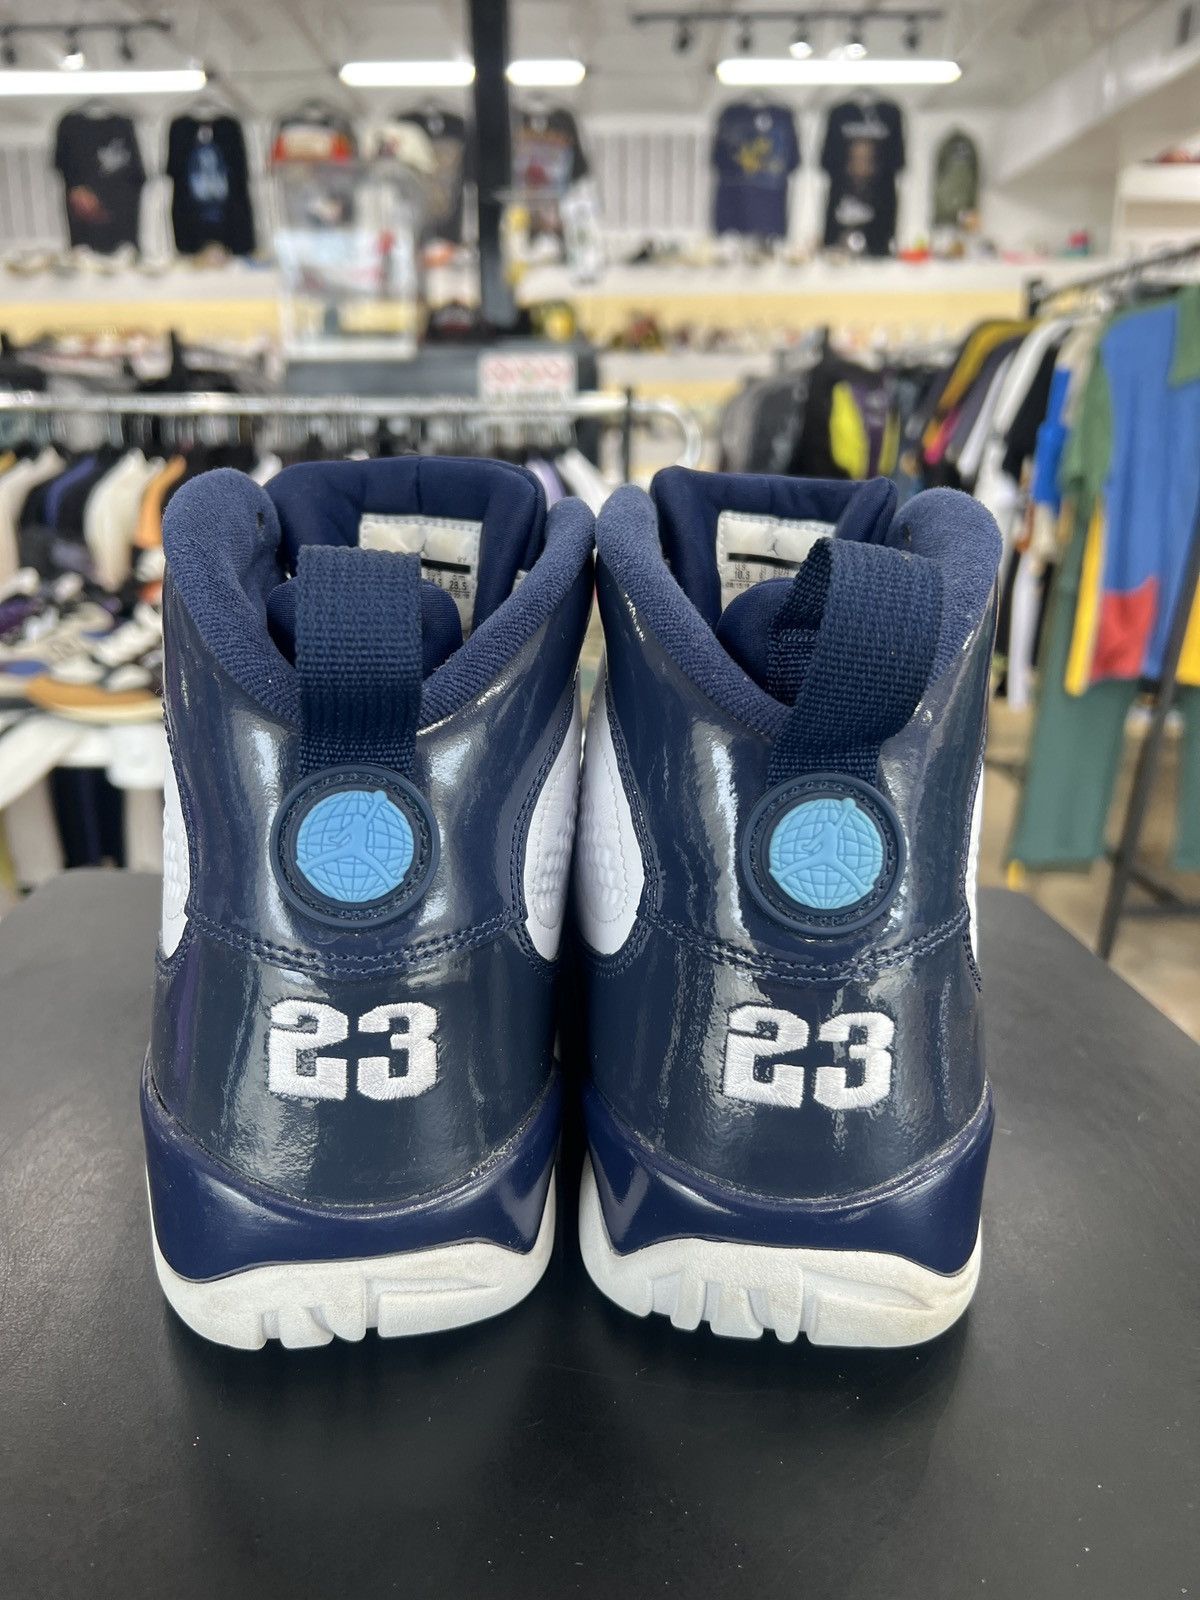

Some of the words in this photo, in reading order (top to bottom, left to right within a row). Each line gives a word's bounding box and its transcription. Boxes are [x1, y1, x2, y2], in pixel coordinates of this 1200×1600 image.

[449, 580, 467, 591] 28.5
[268, 999, 438, 1101] 23
[722, 1004, 895, 1110] 23
